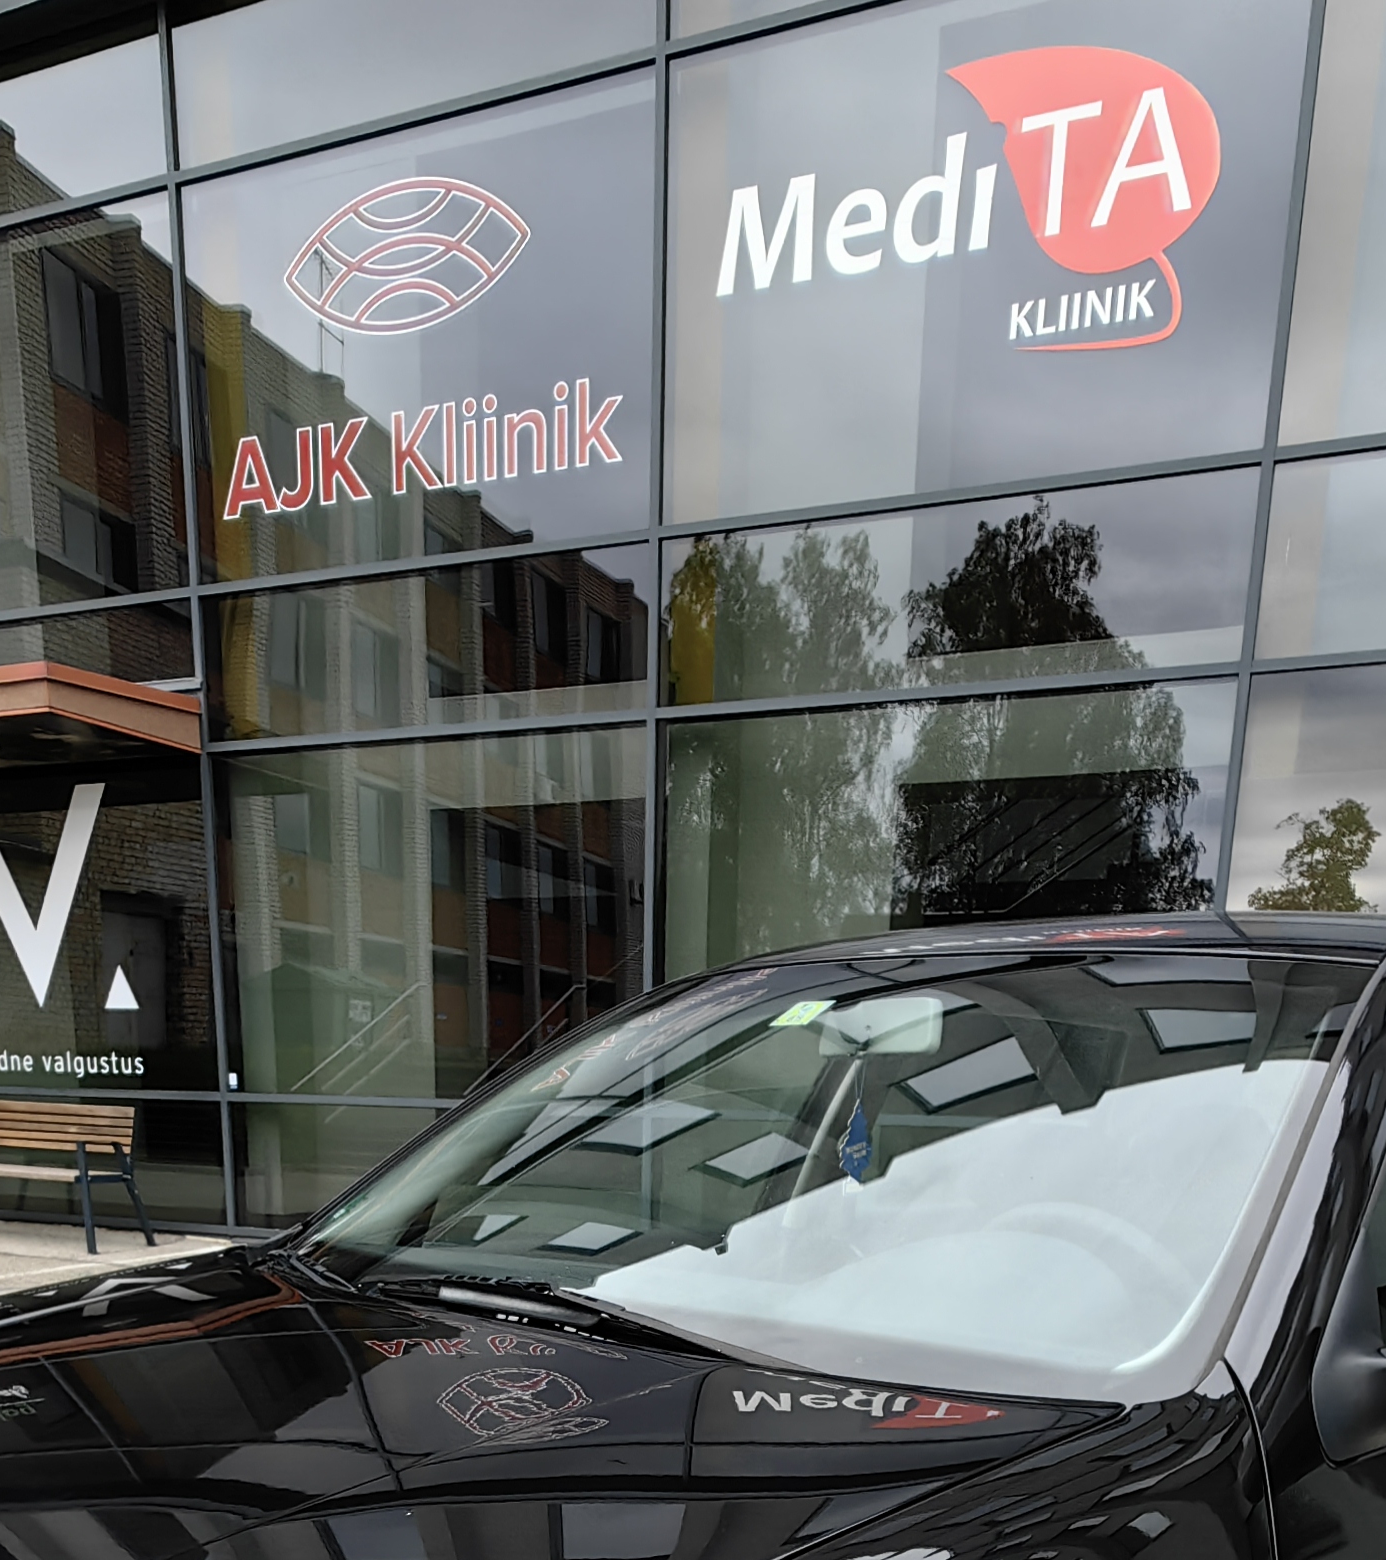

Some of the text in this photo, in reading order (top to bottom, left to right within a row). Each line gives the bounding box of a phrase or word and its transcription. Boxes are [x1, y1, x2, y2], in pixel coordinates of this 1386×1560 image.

[1008, 278, 1157, 342] KLIINIK
[222, 377, 624, 521] AJK Kliinik
[41, 1050, 145, 1079] valgustus
